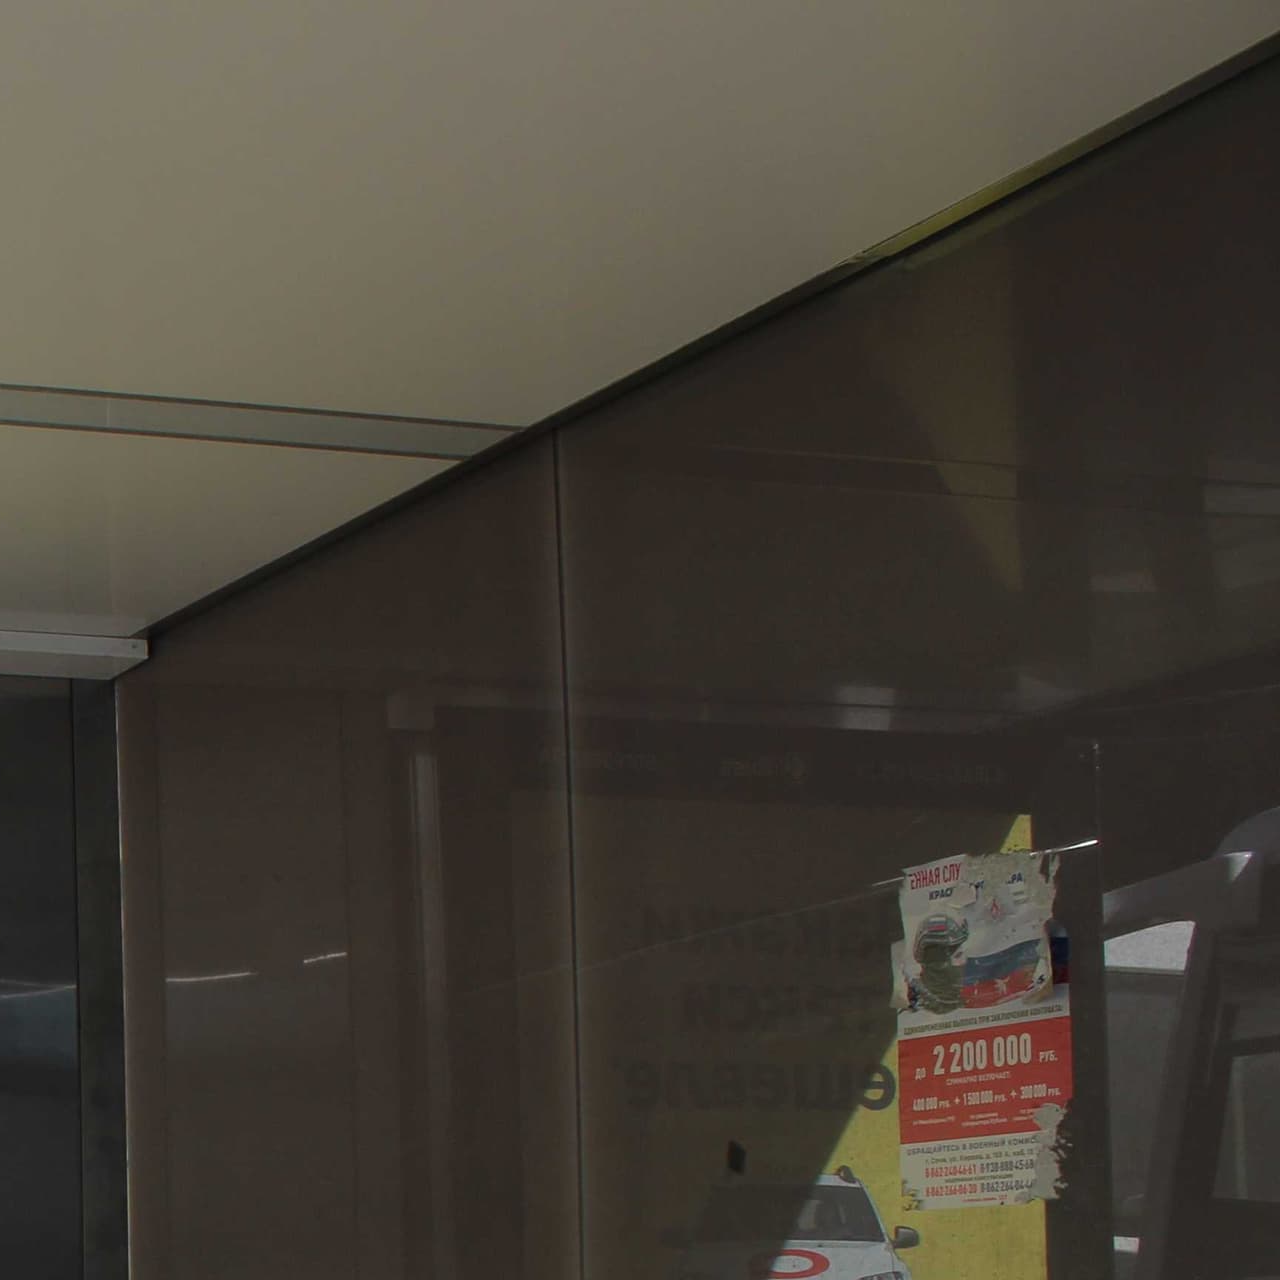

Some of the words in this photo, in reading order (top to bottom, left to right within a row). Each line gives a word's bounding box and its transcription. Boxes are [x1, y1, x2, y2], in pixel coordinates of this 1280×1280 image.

[932, 1044, 945, 1076] 2
[949, 1038, 988, 1073] 200
[992, 1032, 1032, 1068] 000
